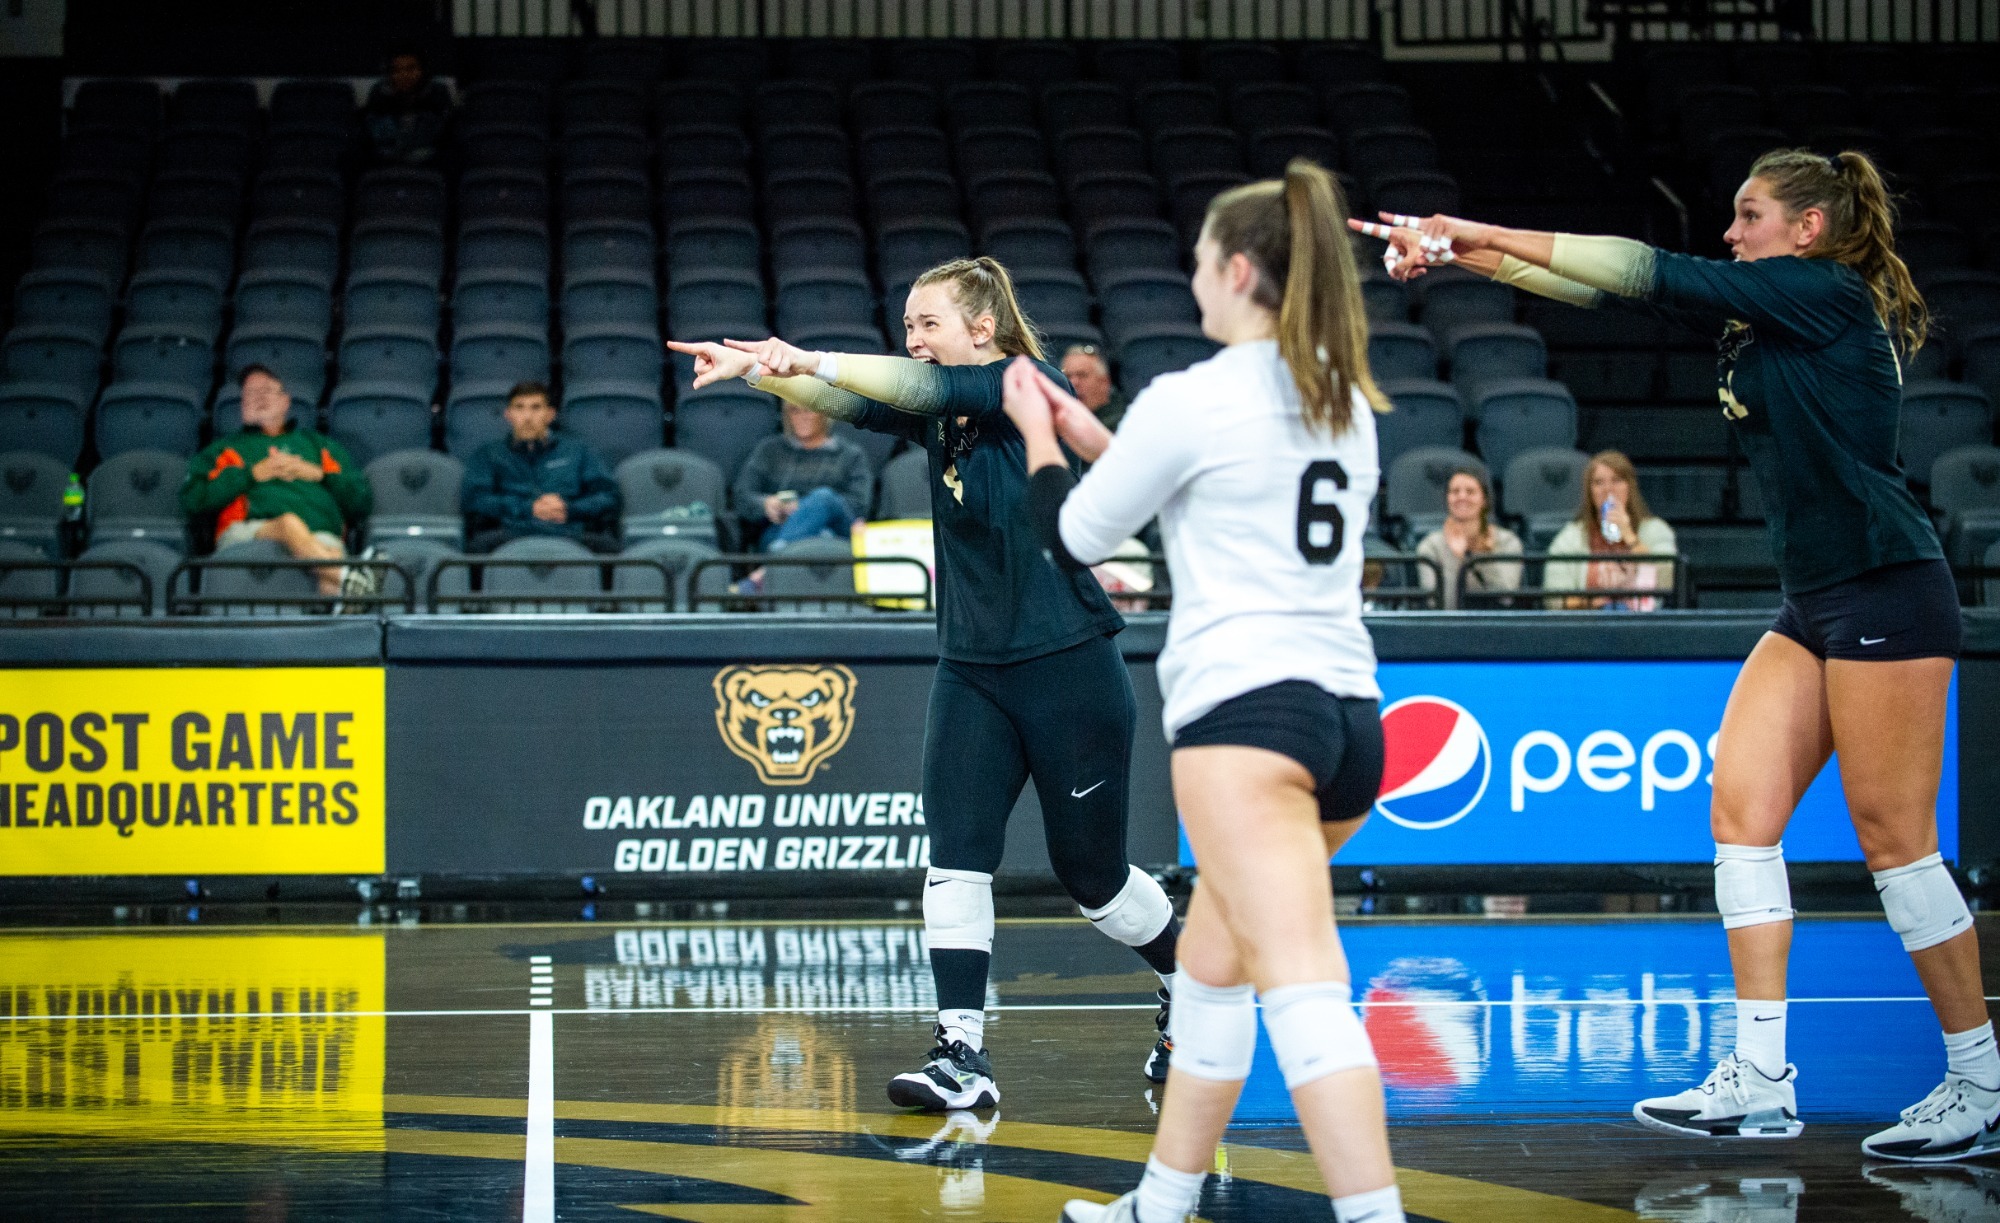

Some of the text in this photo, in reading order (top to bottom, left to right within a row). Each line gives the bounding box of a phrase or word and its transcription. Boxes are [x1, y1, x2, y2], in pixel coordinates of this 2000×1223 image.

[1297, 460, 1348, 565] 6
[171, 711, 354, 772] GAME
[1510, 729, 1719, 812] pep
[583, 795, 767, 830] OAKLAND
[614, 837, 768, 872] GOLDEN
